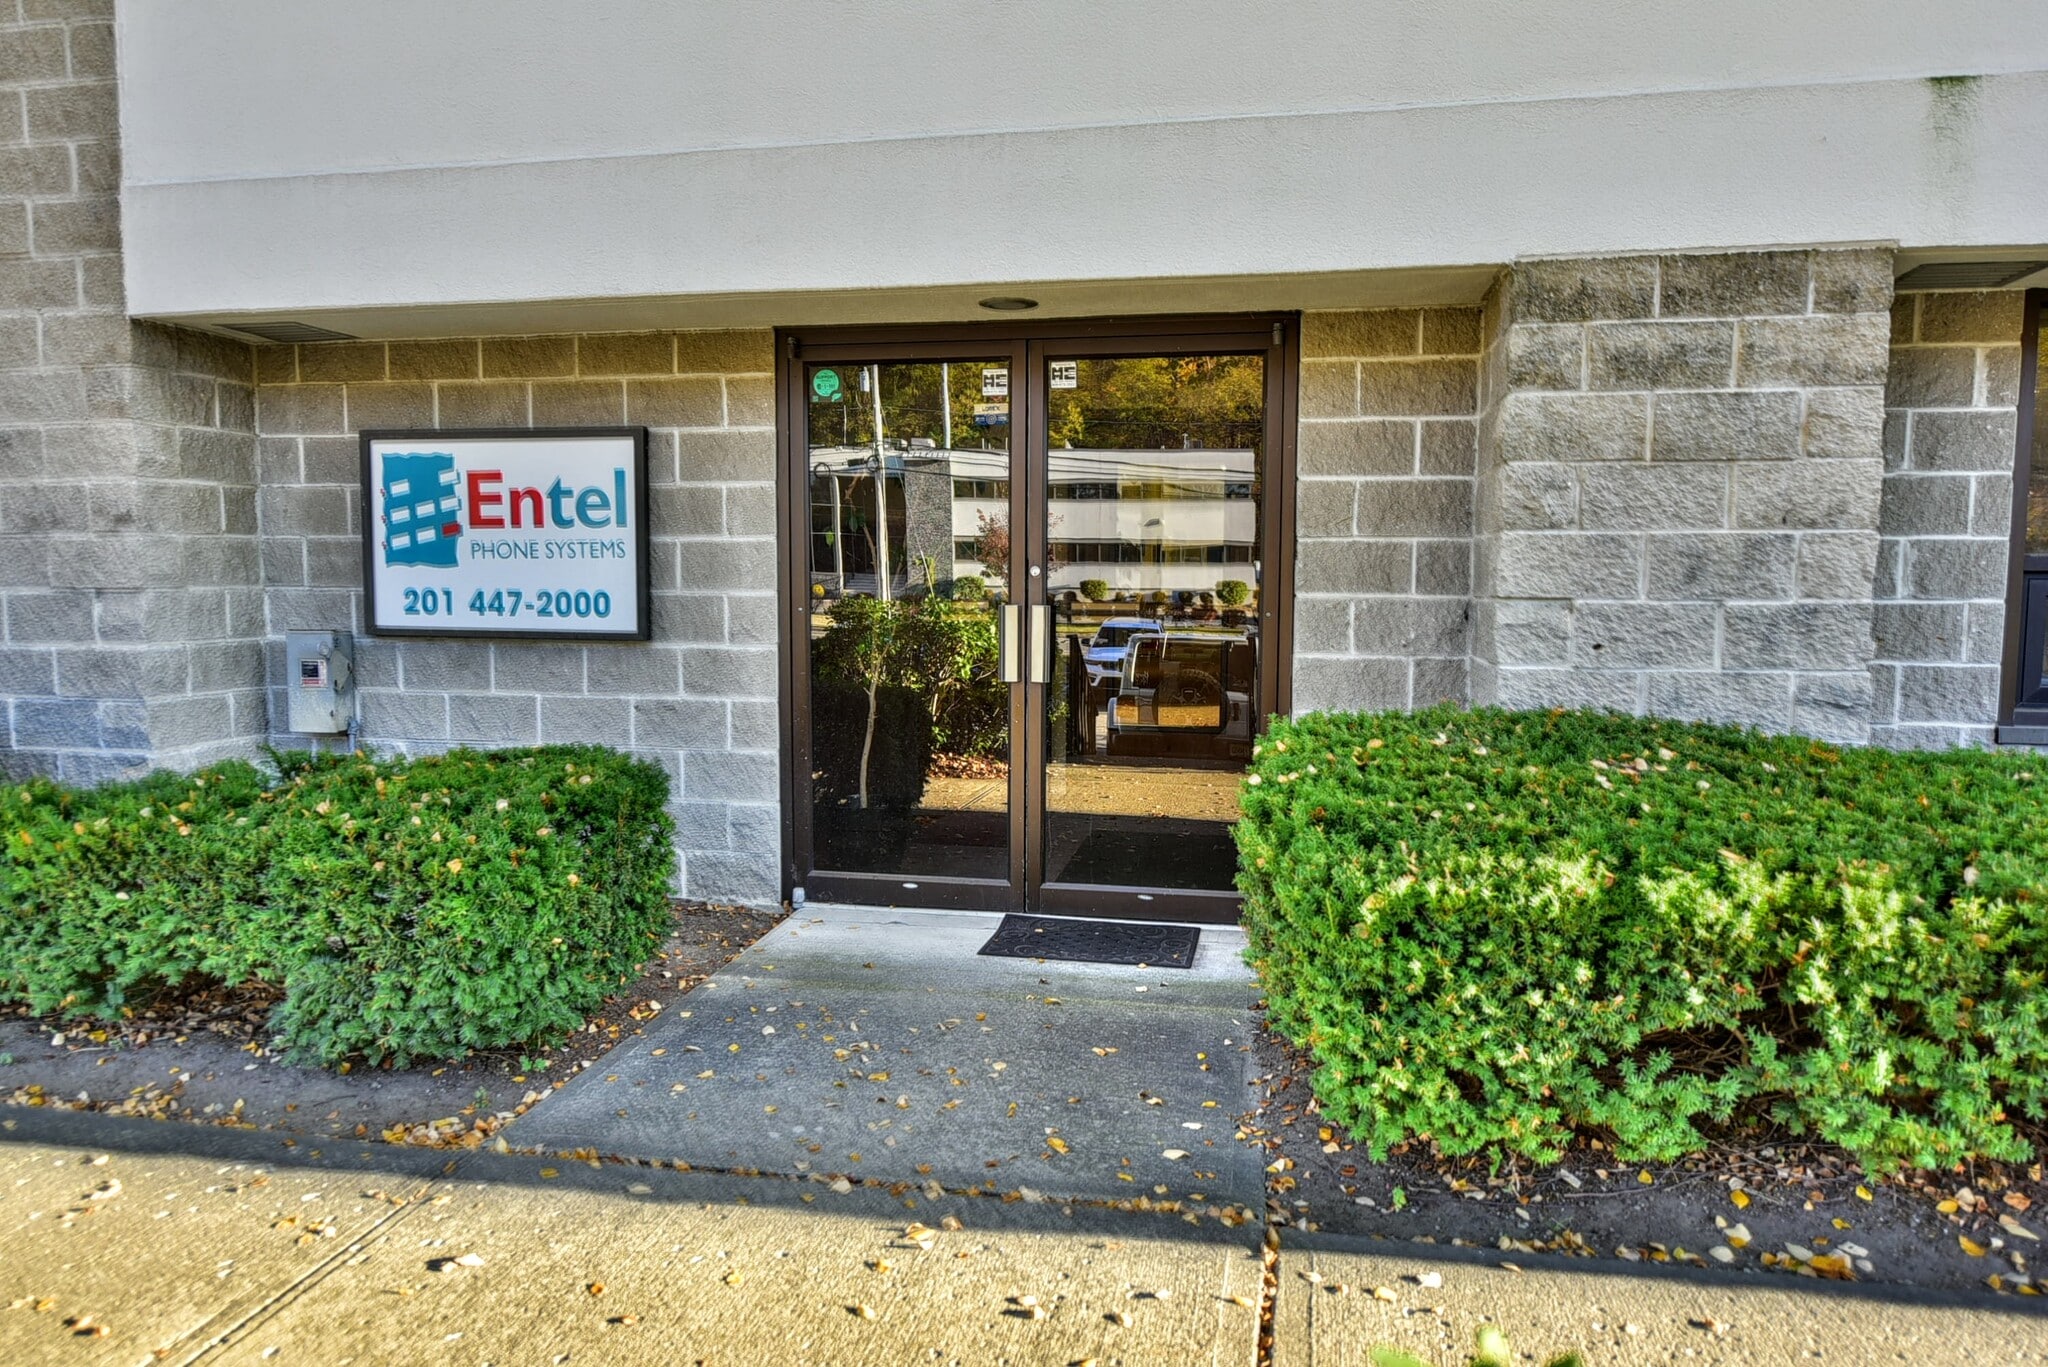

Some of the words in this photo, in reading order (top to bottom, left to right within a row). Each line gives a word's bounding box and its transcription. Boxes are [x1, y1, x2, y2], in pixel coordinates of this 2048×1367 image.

[466, 468, 628, 529] Entel
[470, 539, 540, 560] PHONE
[544, 538, 627, 560] SYSTEMS
[403, 587, 454, 616] 201
[468, 587, 612, 619] 447-2000
